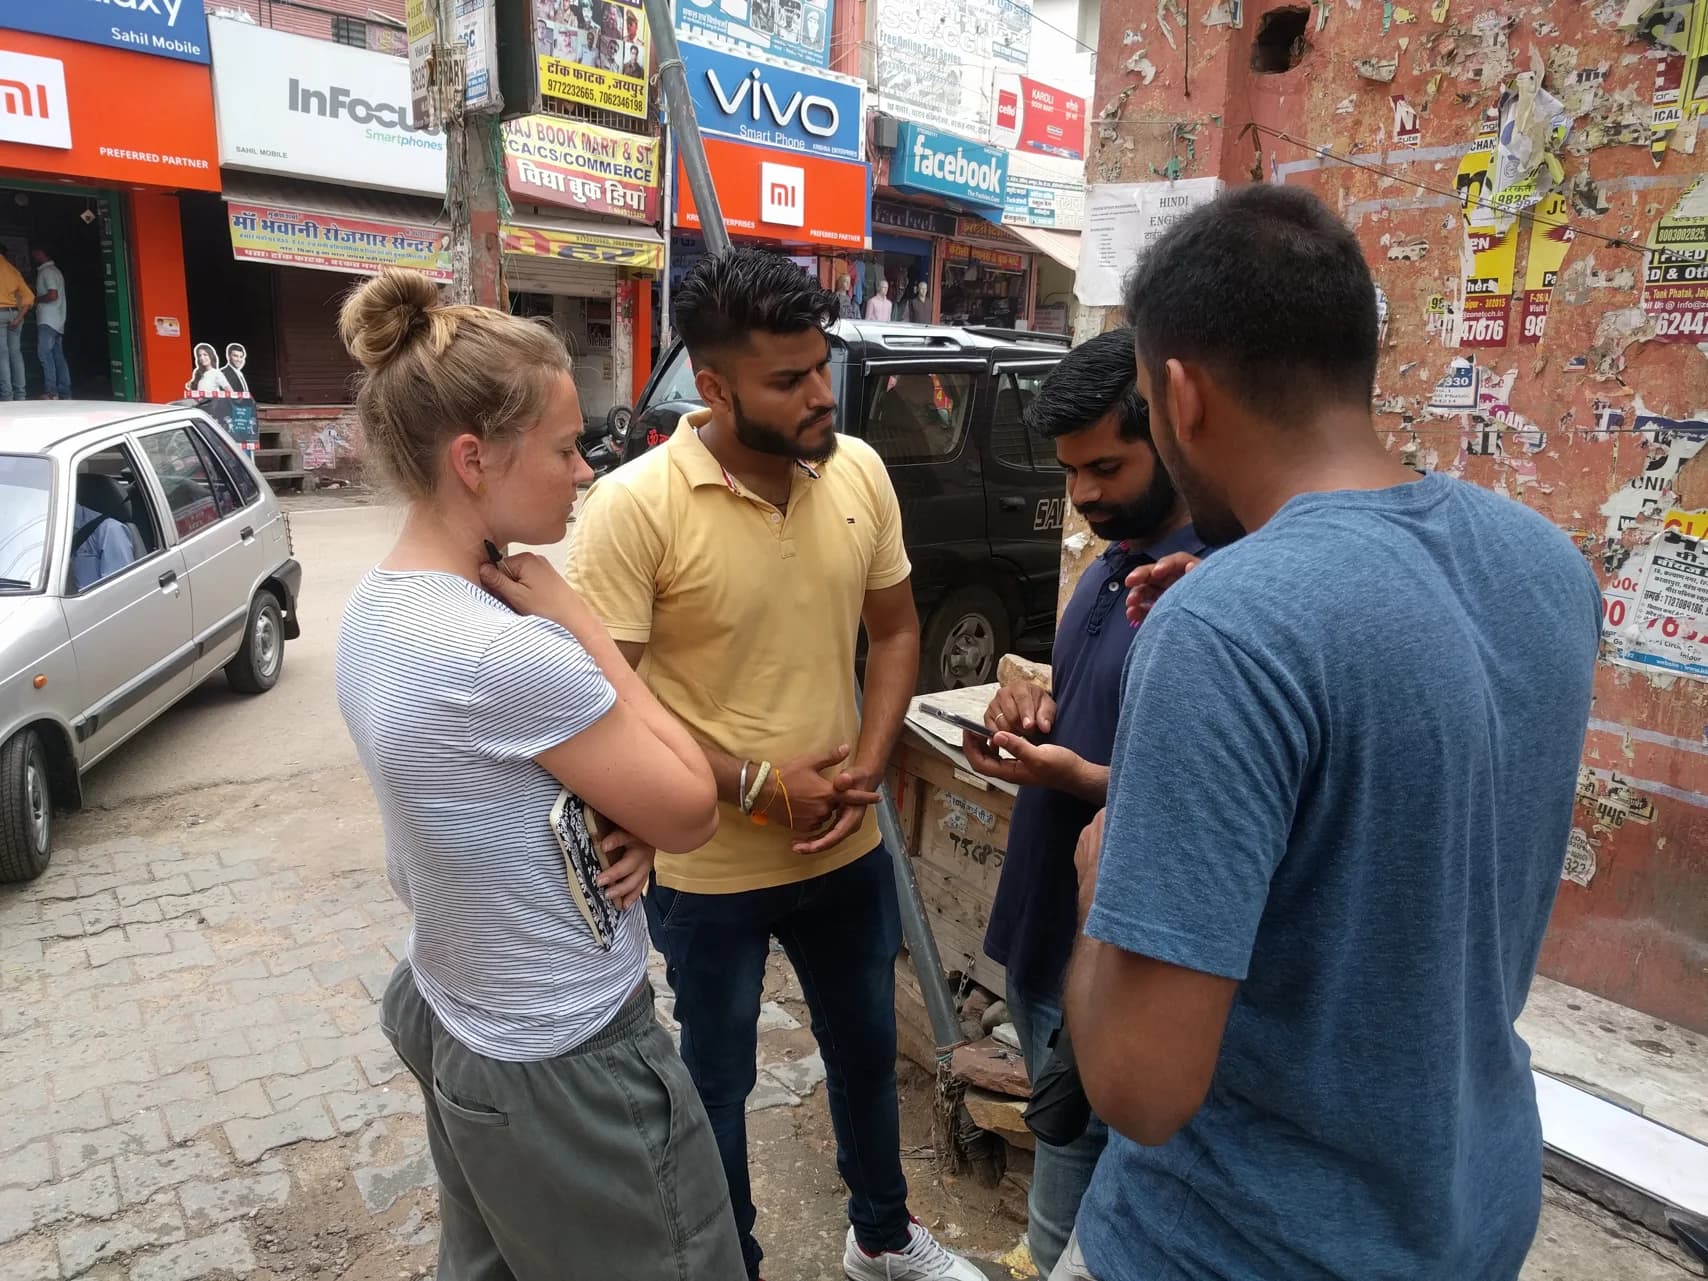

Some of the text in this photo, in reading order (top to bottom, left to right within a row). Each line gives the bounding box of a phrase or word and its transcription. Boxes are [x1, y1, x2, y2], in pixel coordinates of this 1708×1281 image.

[111, 27, 201, 56] Sahil Mobile
[572, 69, 605, 86] फाटक
[288, 78, 440, 136] InFocu
[547, 79, 643, 113] 9772232665, 7062346198
[706, 67, 840, 138] vivo
[366, 129, 443, 151] Smartphones
[536, 123, 577, 149] BOOK
[582, 131, 617, 158] MART
[623, 143, 631, 161] &
[739, 125, 806, 150] Smart Phone
[100, 147, 209, 169] PREFERRED PARTNER
[235, 146, 288, 159] SAHIL MOBILE
[508, 139, 652, 183] CA/CS/COMMERCE
[913, 134, 1002, 194] facebook
[568, 176, 602, 204] बुक
[604, 179, 647, 211] डिपो
[1159, 195, 1188, 208] HINDI
[261, 219, 318, 240] भवानी
[323, 225, 387, 248] रोजगार
[810, 230, 861, 242] PREFERRED PARTNER
[1666, 268, 1678, 280] &
[1666, 301, 1675, 310] @
